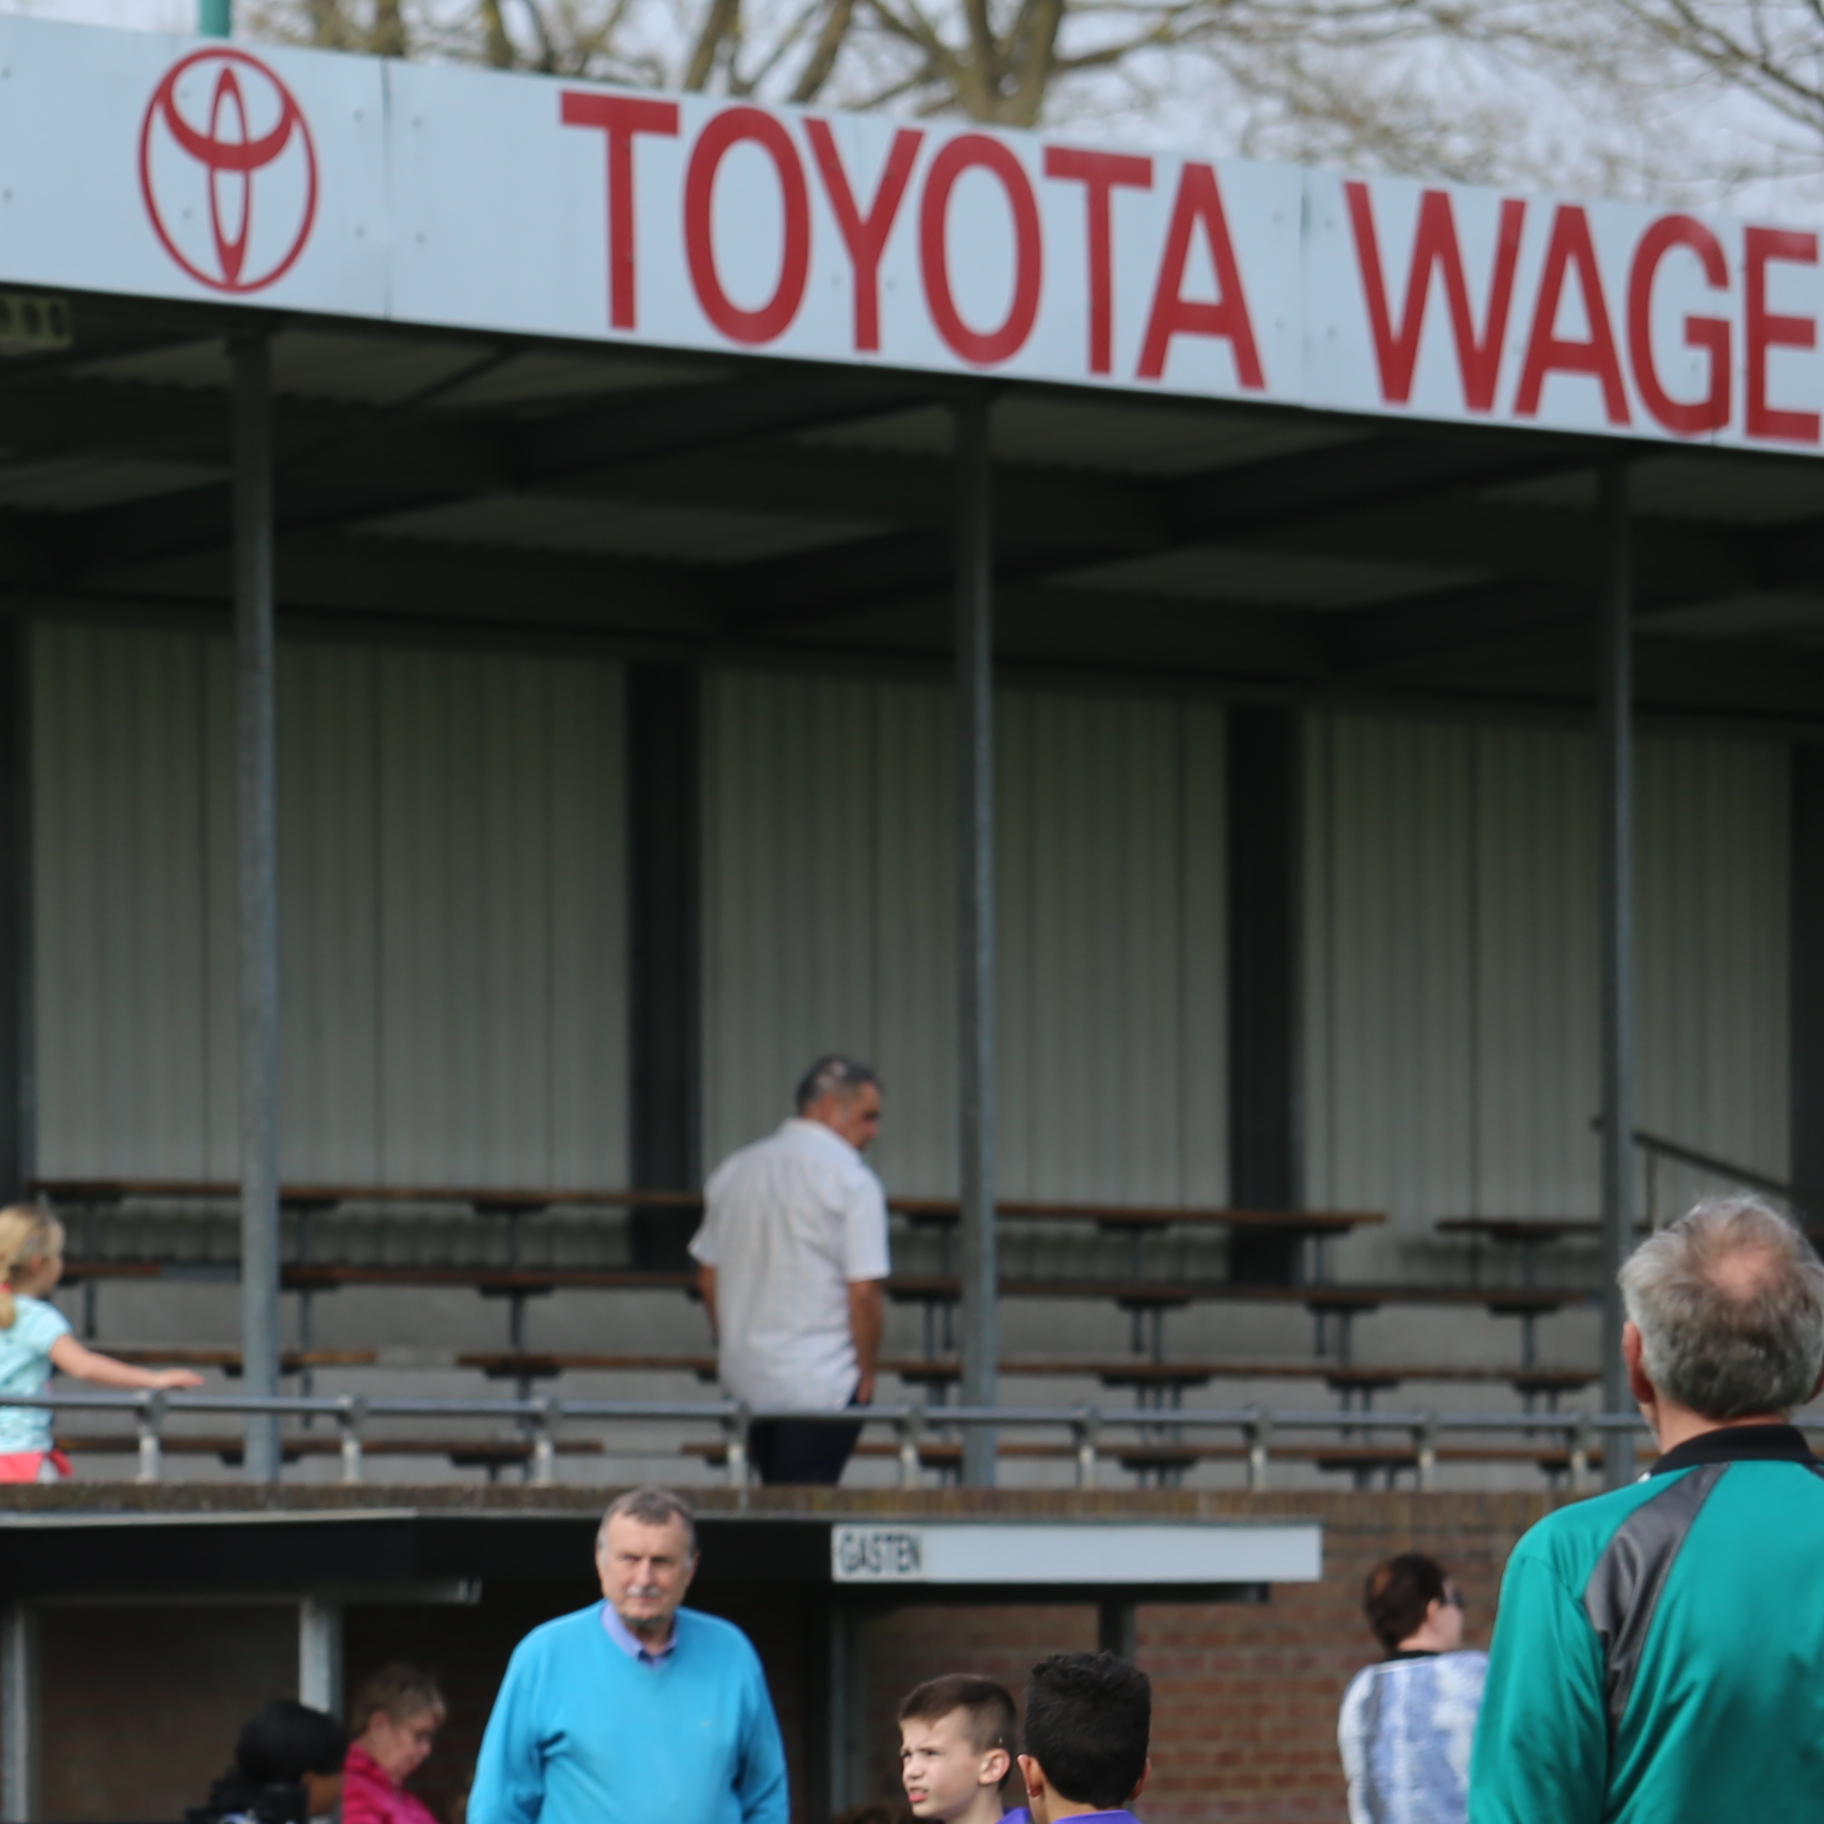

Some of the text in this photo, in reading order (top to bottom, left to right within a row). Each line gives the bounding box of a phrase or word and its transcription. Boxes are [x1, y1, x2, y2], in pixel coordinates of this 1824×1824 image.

[560, 90, 1820, 443] TOYOTA WAGE
[839, 1533, 922, 1574] GASTEN
